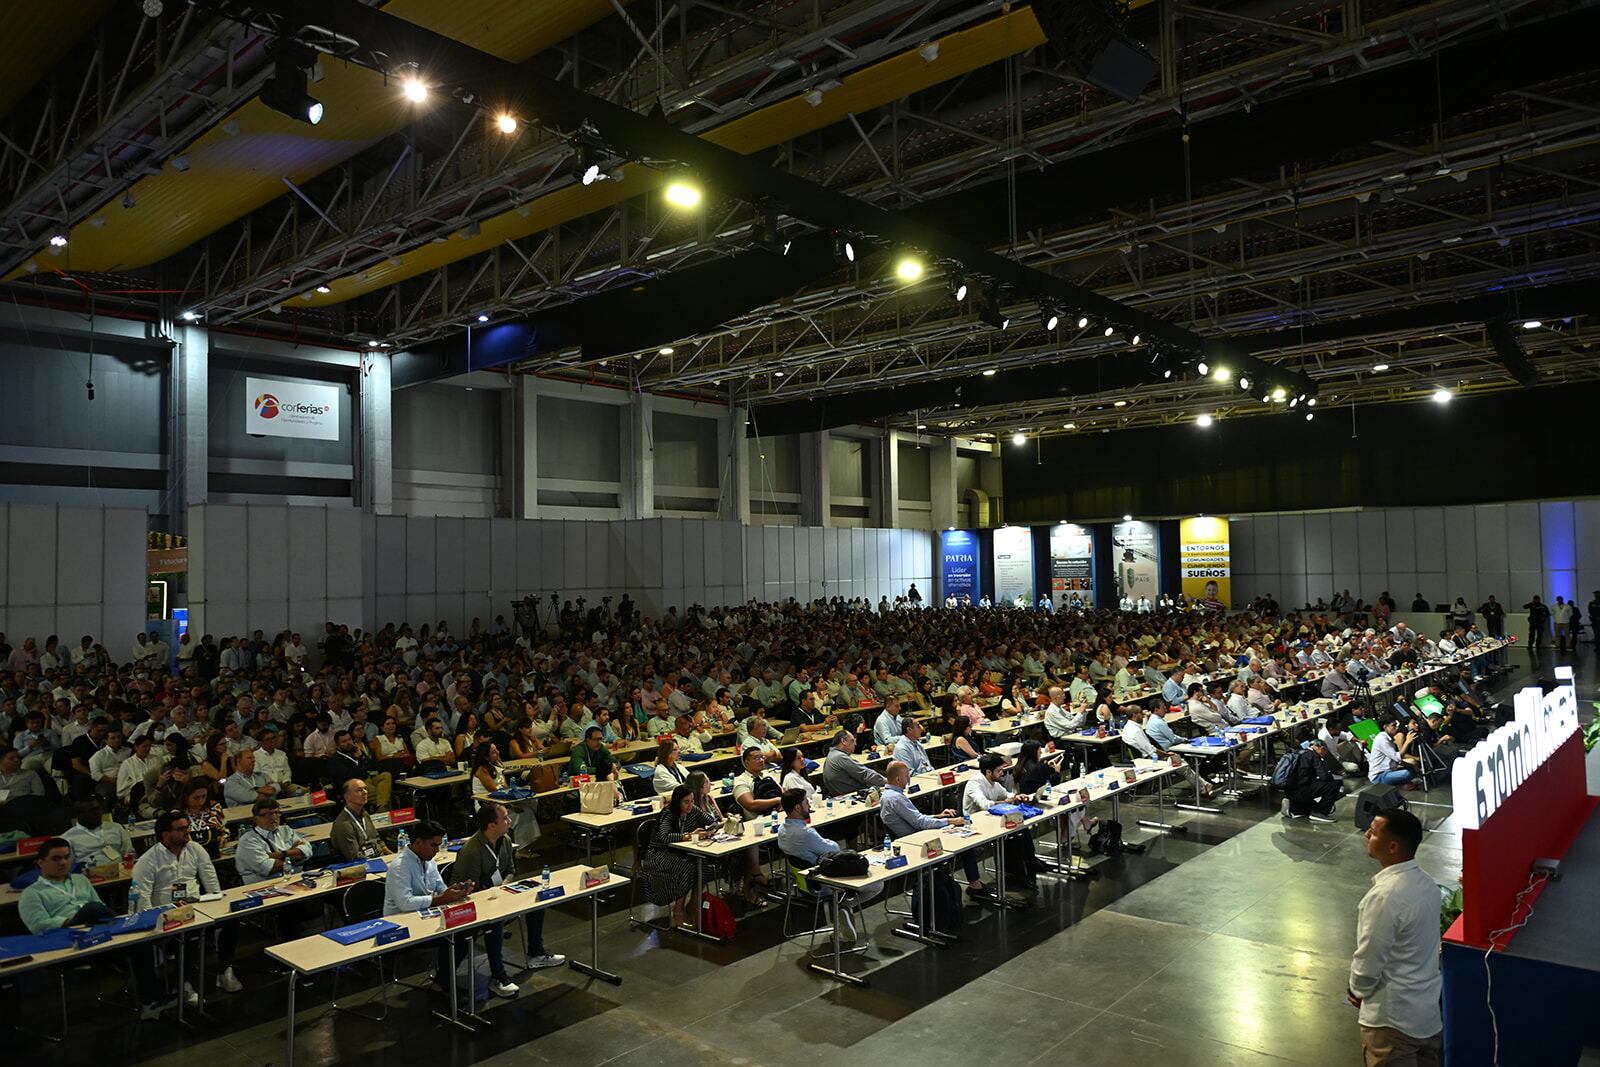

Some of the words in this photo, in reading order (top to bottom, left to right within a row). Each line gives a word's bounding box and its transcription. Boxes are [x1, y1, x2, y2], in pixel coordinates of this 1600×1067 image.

[281, 403, 323, 415] corferias
[945, 554, 973, 562] PATRIA
[1187, 568, 1226, 577] SUEÑOS
